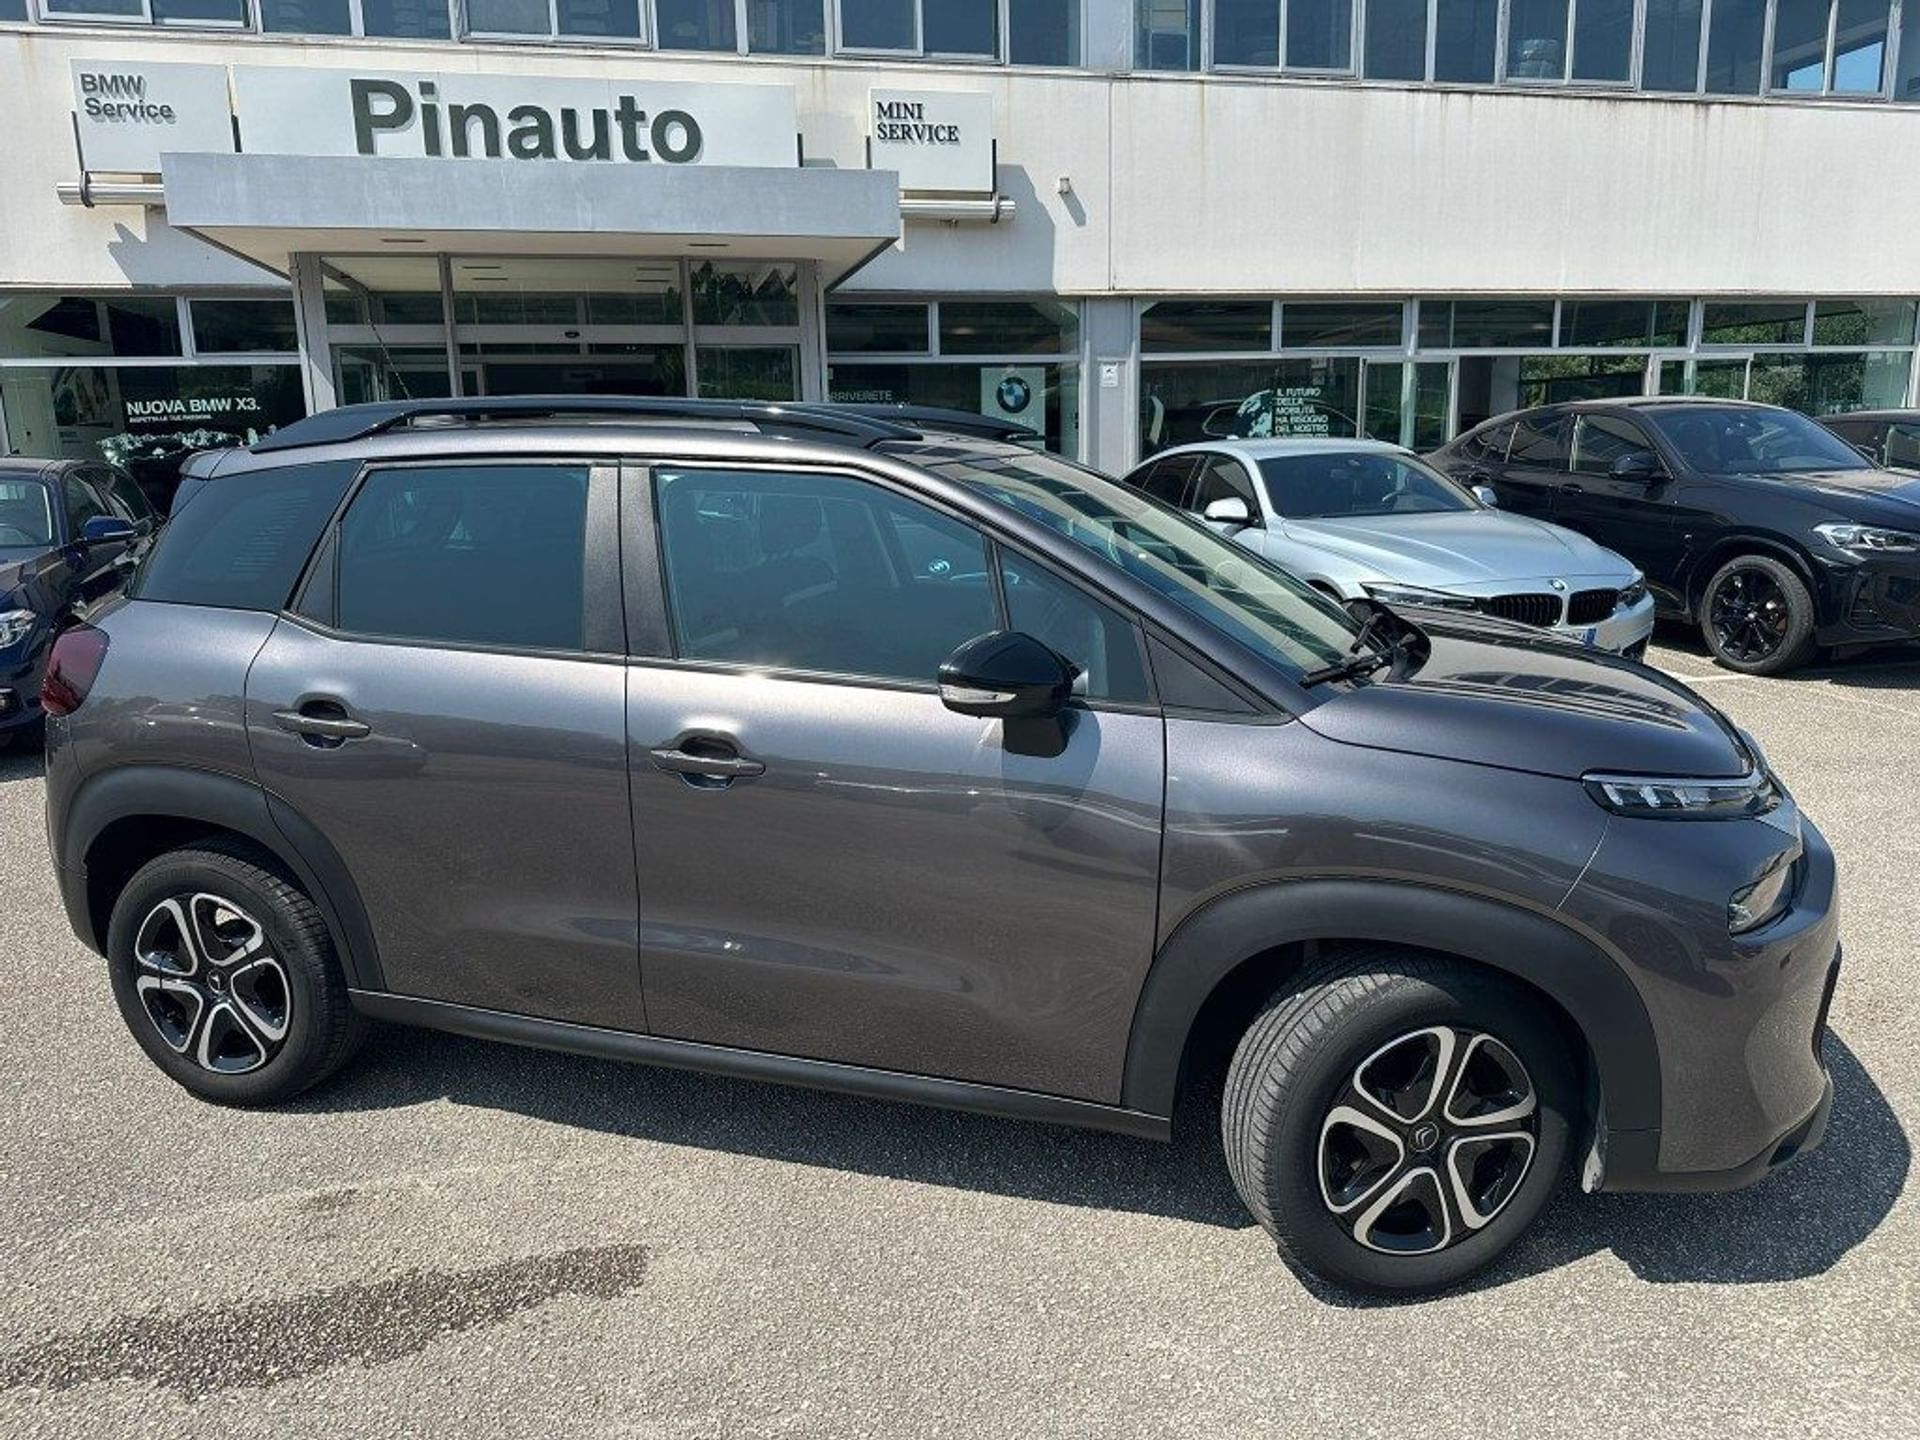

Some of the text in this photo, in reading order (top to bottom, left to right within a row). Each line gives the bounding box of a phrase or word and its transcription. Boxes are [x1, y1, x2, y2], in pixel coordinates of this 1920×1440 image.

[80, 73, 145, 97] BMW
[84, 97, 173, 121] Service
[876, 101, 923, 120] MINI
[350, 78, 702, 163] Pinauto
[877, 122, 959, 143] SERVICE
[126, 397, 261, 415] NUOVA BMW X3.
